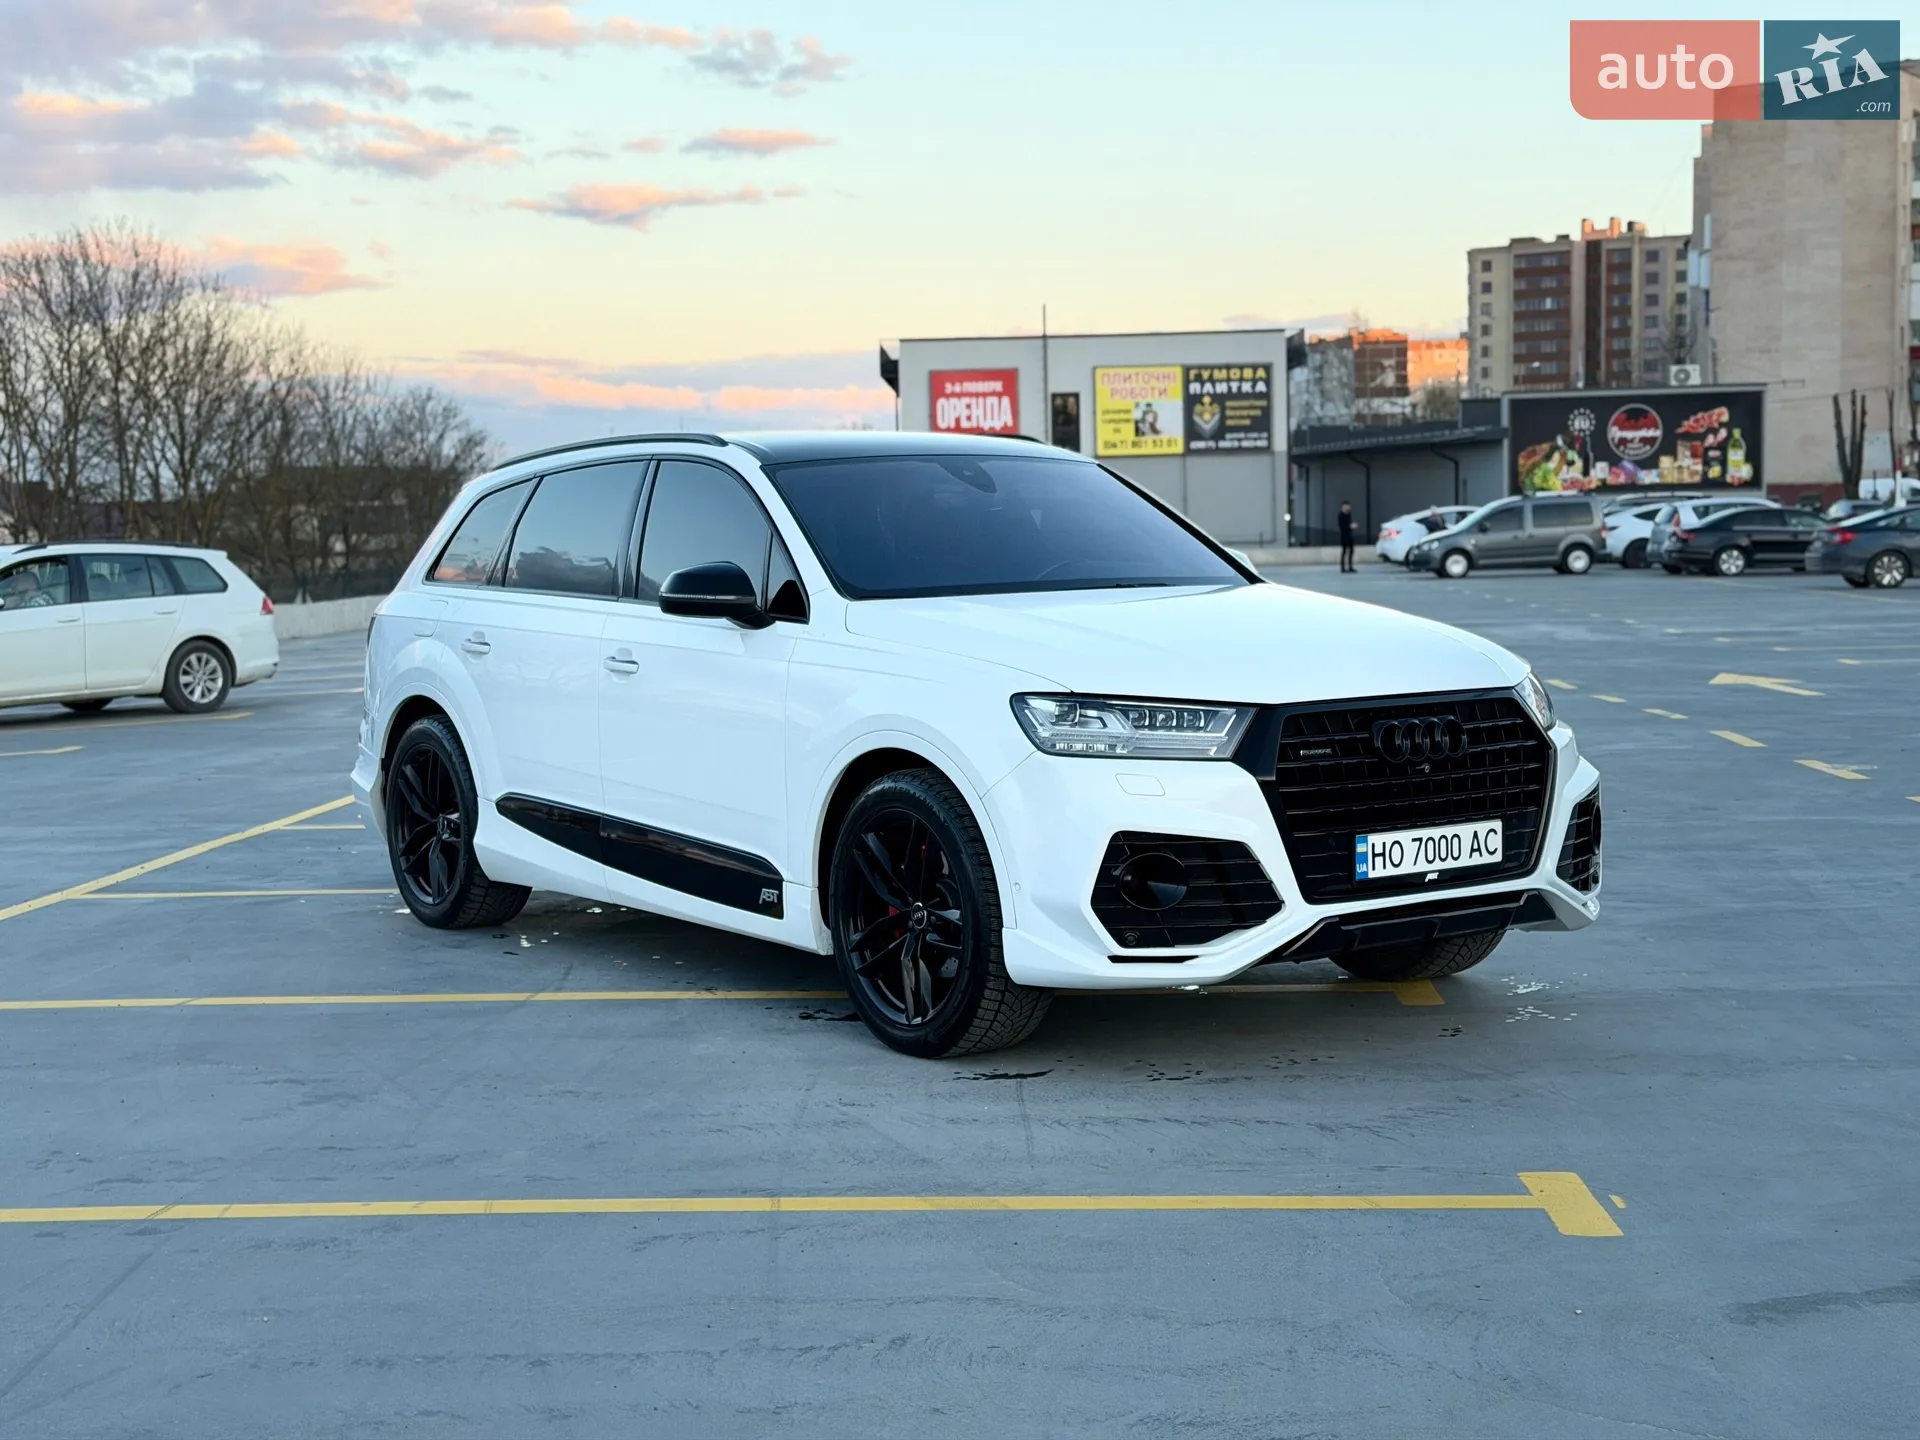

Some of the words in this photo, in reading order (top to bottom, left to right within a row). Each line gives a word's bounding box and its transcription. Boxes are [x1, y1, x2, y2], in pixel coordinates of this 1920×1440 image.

[1101, 371, 1177, 386] ПЛИТОЧНІ
[1188, 367, 1267, 381] ГУМОВА
[1109, 386, 1169, 401] РОБОТИ
[1188, 380, 1268, 395] ПЛИТКА
[936, 395, 1013, 431] ОРЕНДА
[1371, 840, 1404, 871] HO
[1411, 833, 1461, 866] 7000
[1469, 828, 1498, 859] AC
[1356, 863, 1367, 873] UA
[759, 888, 779, 904] ABT
